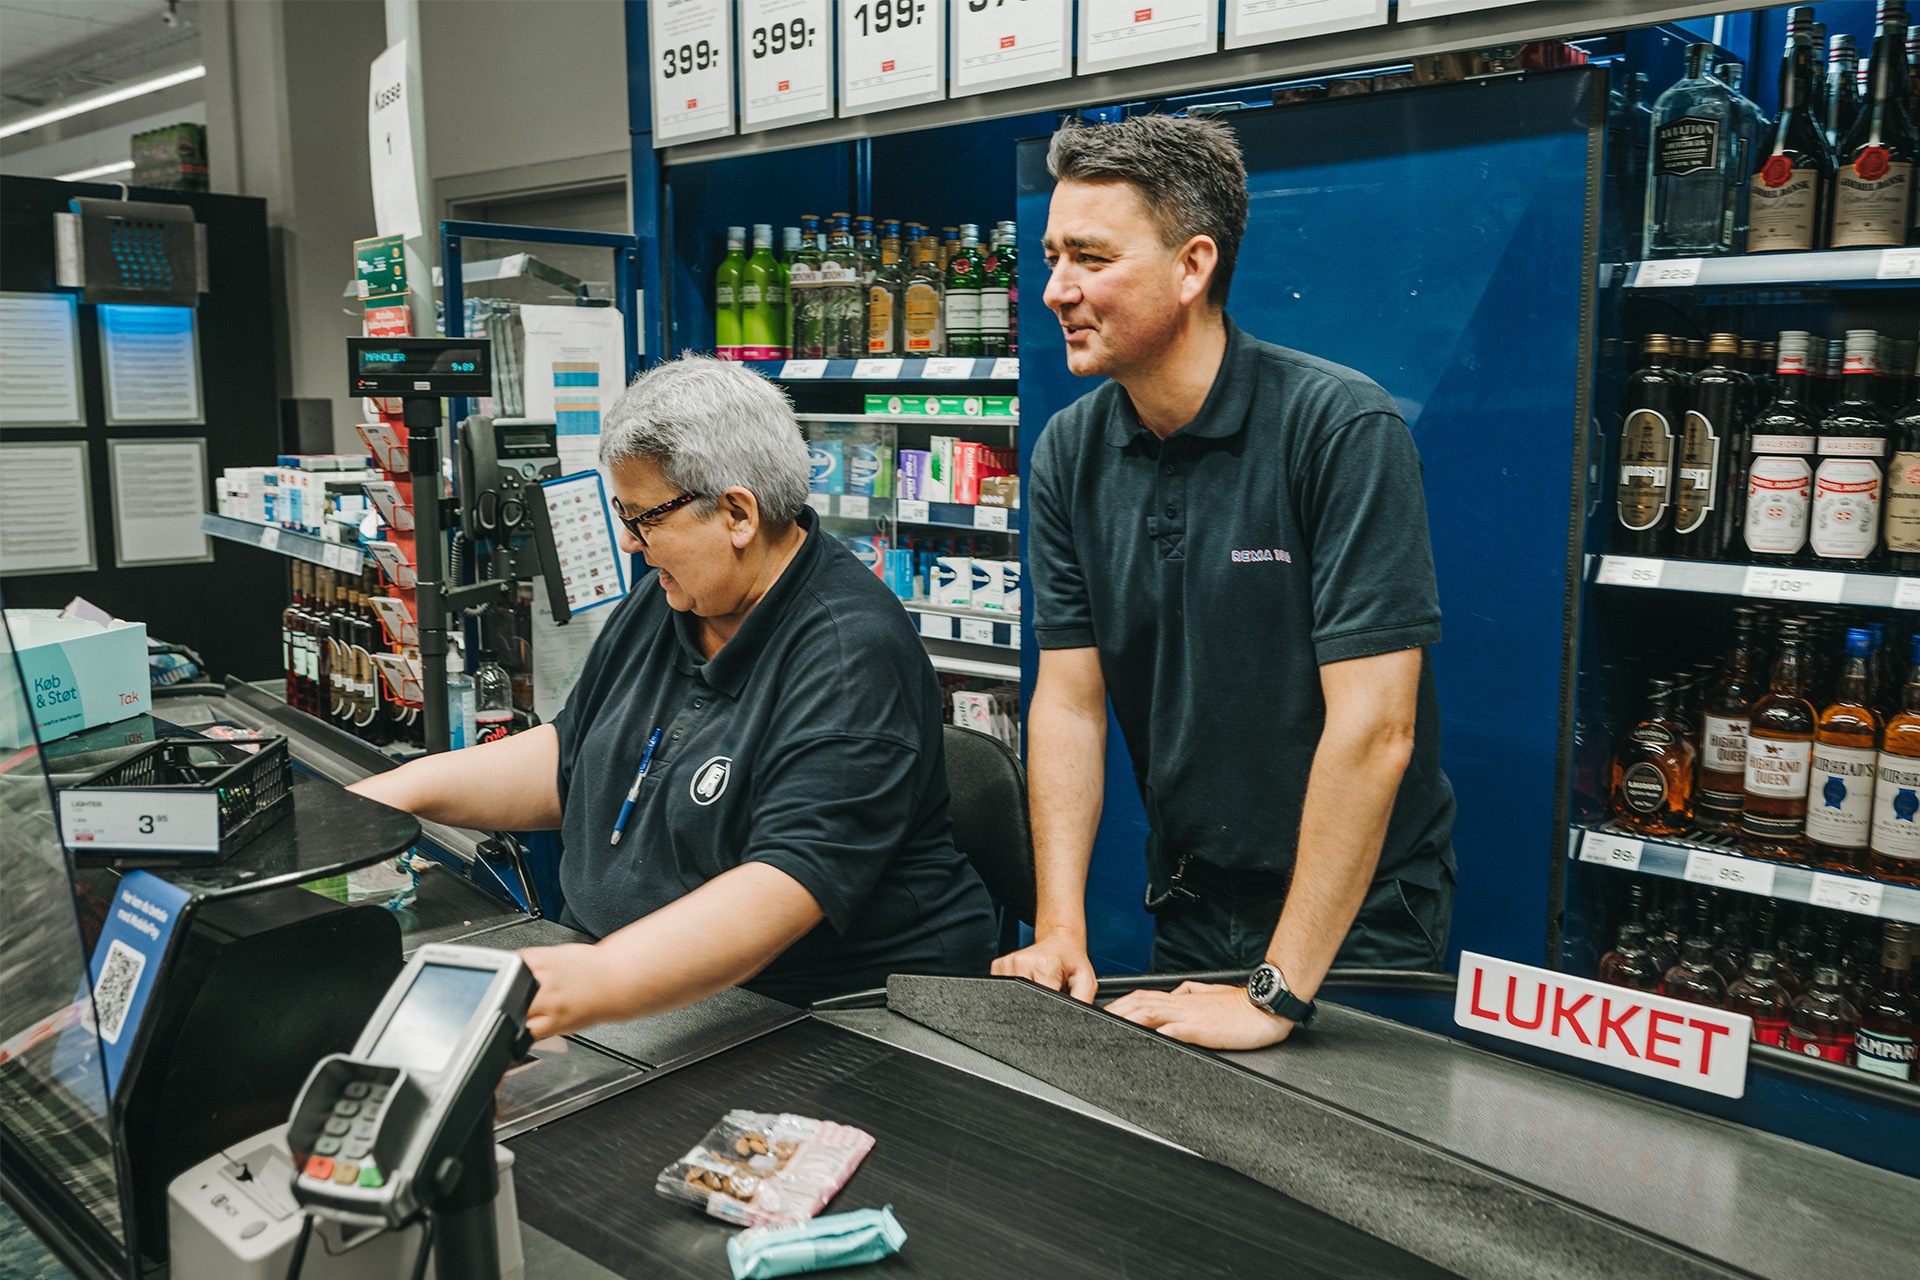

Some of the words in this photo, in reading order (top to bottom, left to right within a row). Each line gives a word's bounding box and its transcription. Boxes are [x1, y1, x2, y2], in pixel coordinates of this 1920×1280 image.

[1231, 549, 1273, 563] REMA
[34, 674, 61, 692] Køb
[36, 694, 46, 709] &
[48, 687, 78, 706] Støt
[118, 691, 139, 706] Tak
[1749, 754, 1801, 774] HIGHLAND
[1754, 769, 1791, 786] QUEEN
[139, 815, 155, 835] 3
[1470, 967, 1730, 1076] LUKKET
[1855, 1031, 1920, 1061] CAMPARI
